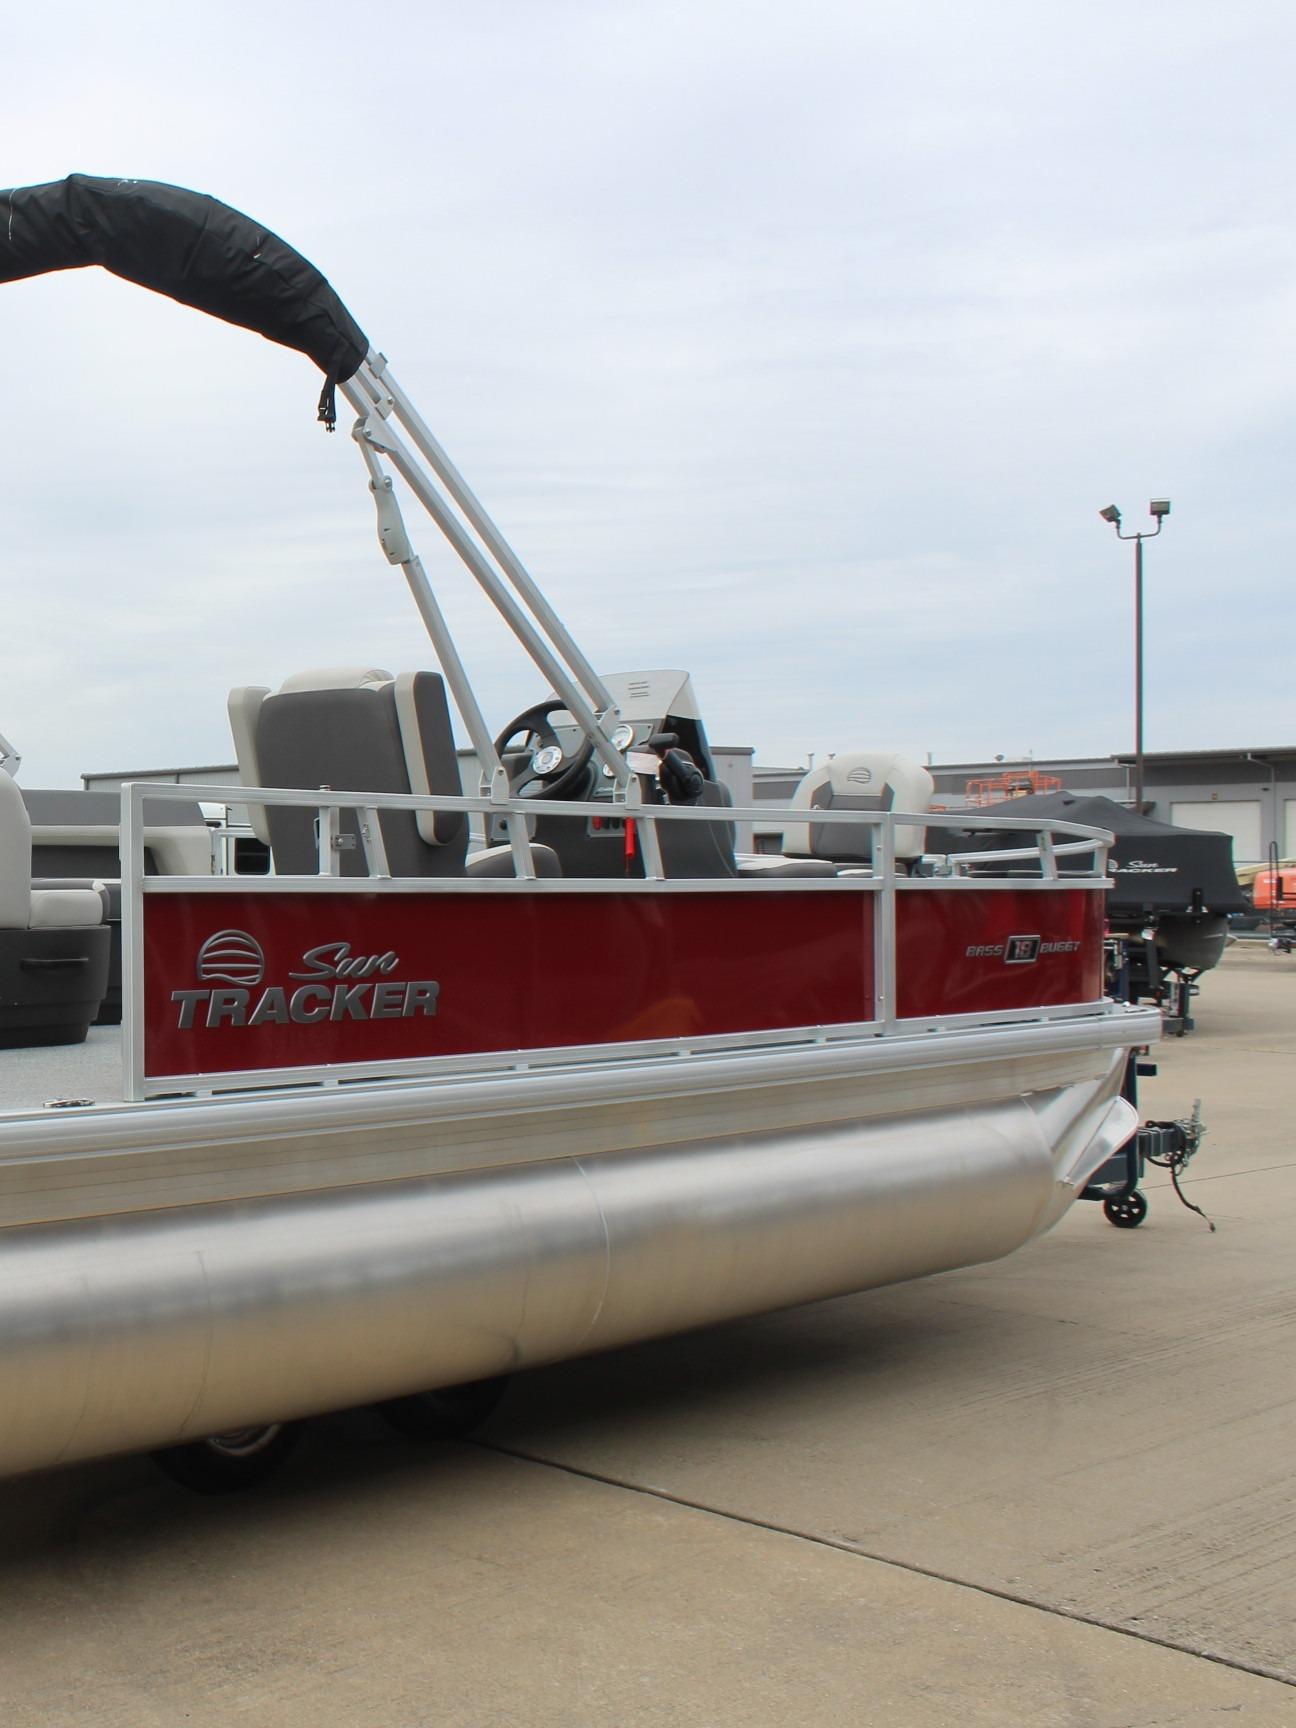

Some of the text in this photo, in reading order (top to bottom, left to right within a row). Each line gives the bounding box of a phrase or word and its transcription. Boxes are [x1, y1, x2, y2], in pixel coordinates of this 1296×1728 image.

[289, 942, 399, 979] Sun
[966, 945, 1003, 957] BASS
[171, 981, 439, 1029] TRACKER
